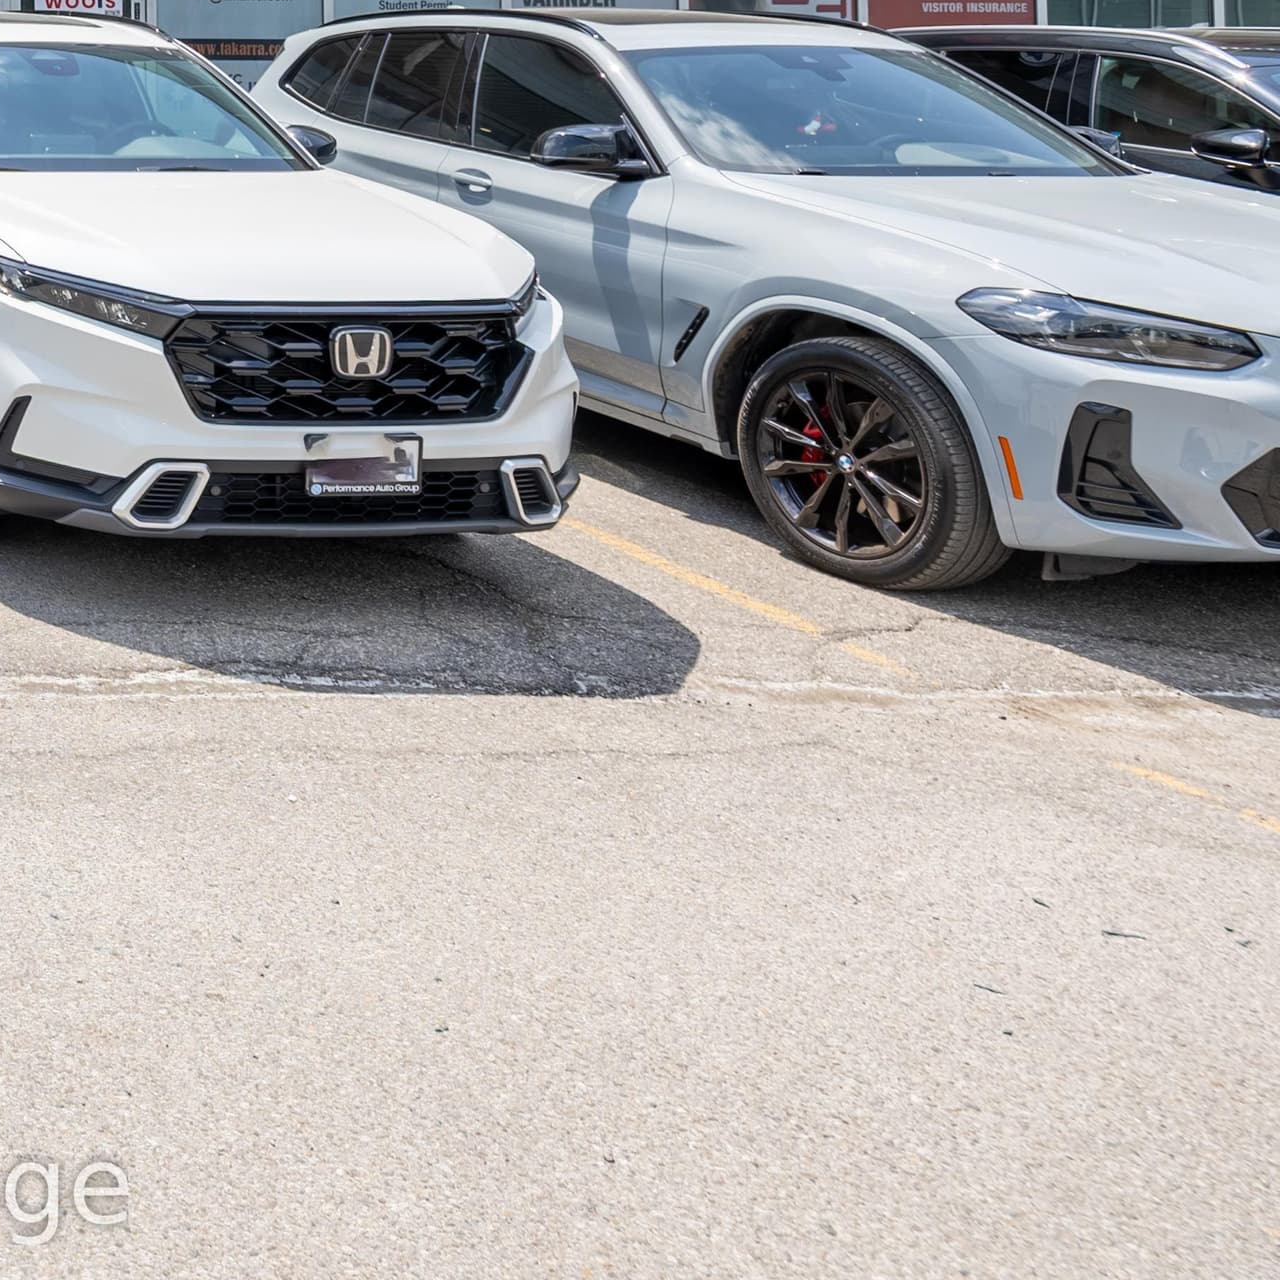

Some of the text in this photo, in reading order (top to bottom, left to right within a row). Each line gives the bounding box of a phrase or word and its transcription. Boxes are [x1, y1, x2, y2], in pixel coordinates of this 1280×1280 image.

[378, 0, 453, 10] Student Permit
[922, 2, 1028, 13] VISITOR INSURANCE
[323, 484, 420, 494] Performance Auto Group
